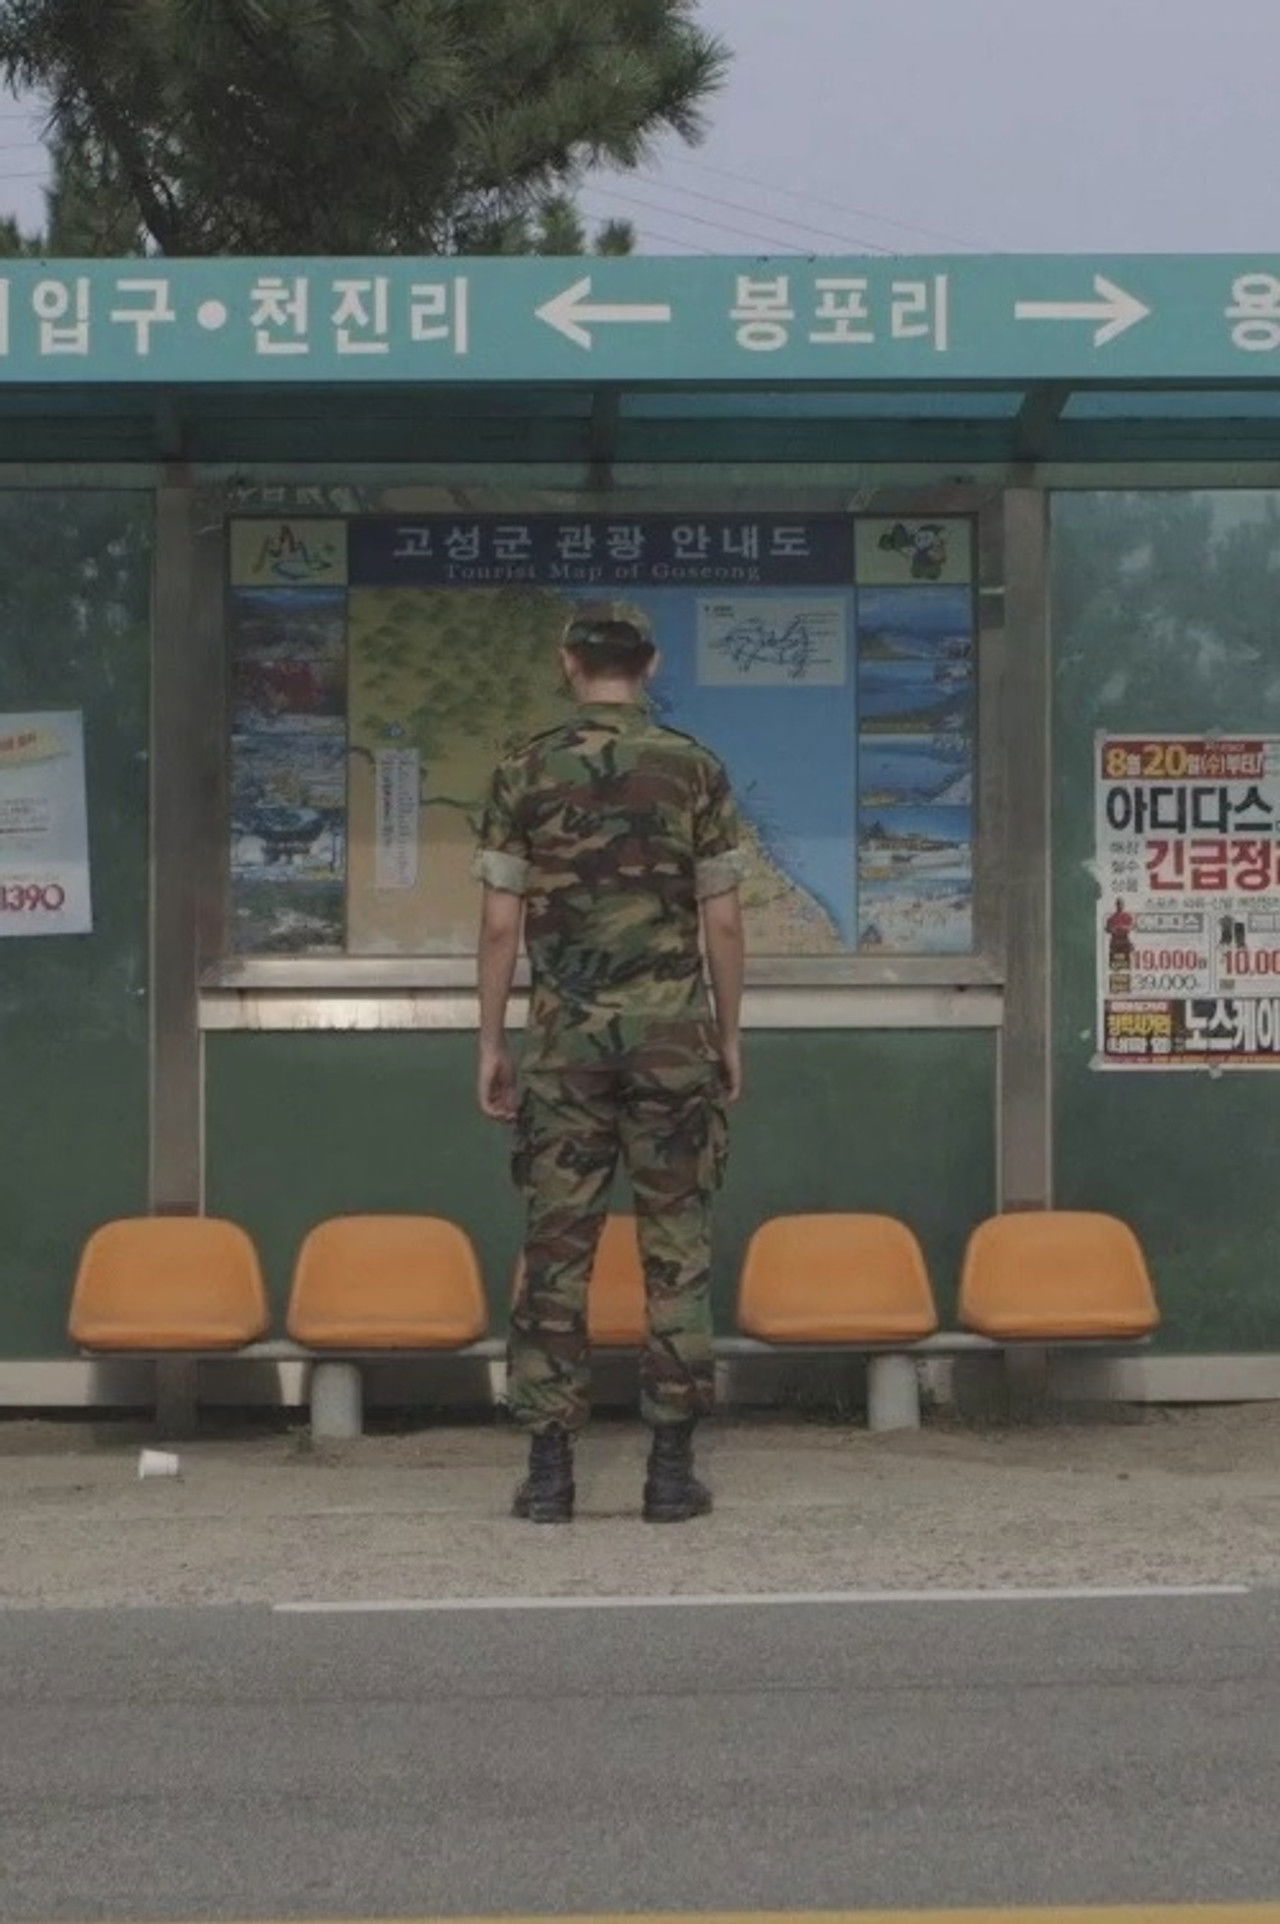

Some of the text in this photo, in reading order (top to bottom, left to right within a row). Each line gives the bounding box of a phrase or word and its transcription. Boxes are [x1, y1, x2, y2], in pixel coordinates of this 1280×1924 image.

[729, 274, 947, 351] 봉포리
[393, 523, 811, 561] 고성군 관광 안내도
[446, 562, 761, 582] Tourist Map of Goseong
[1106, 786, 1273, 833] 아디다스
[1146, 839, 1280, 891] 긴급정
